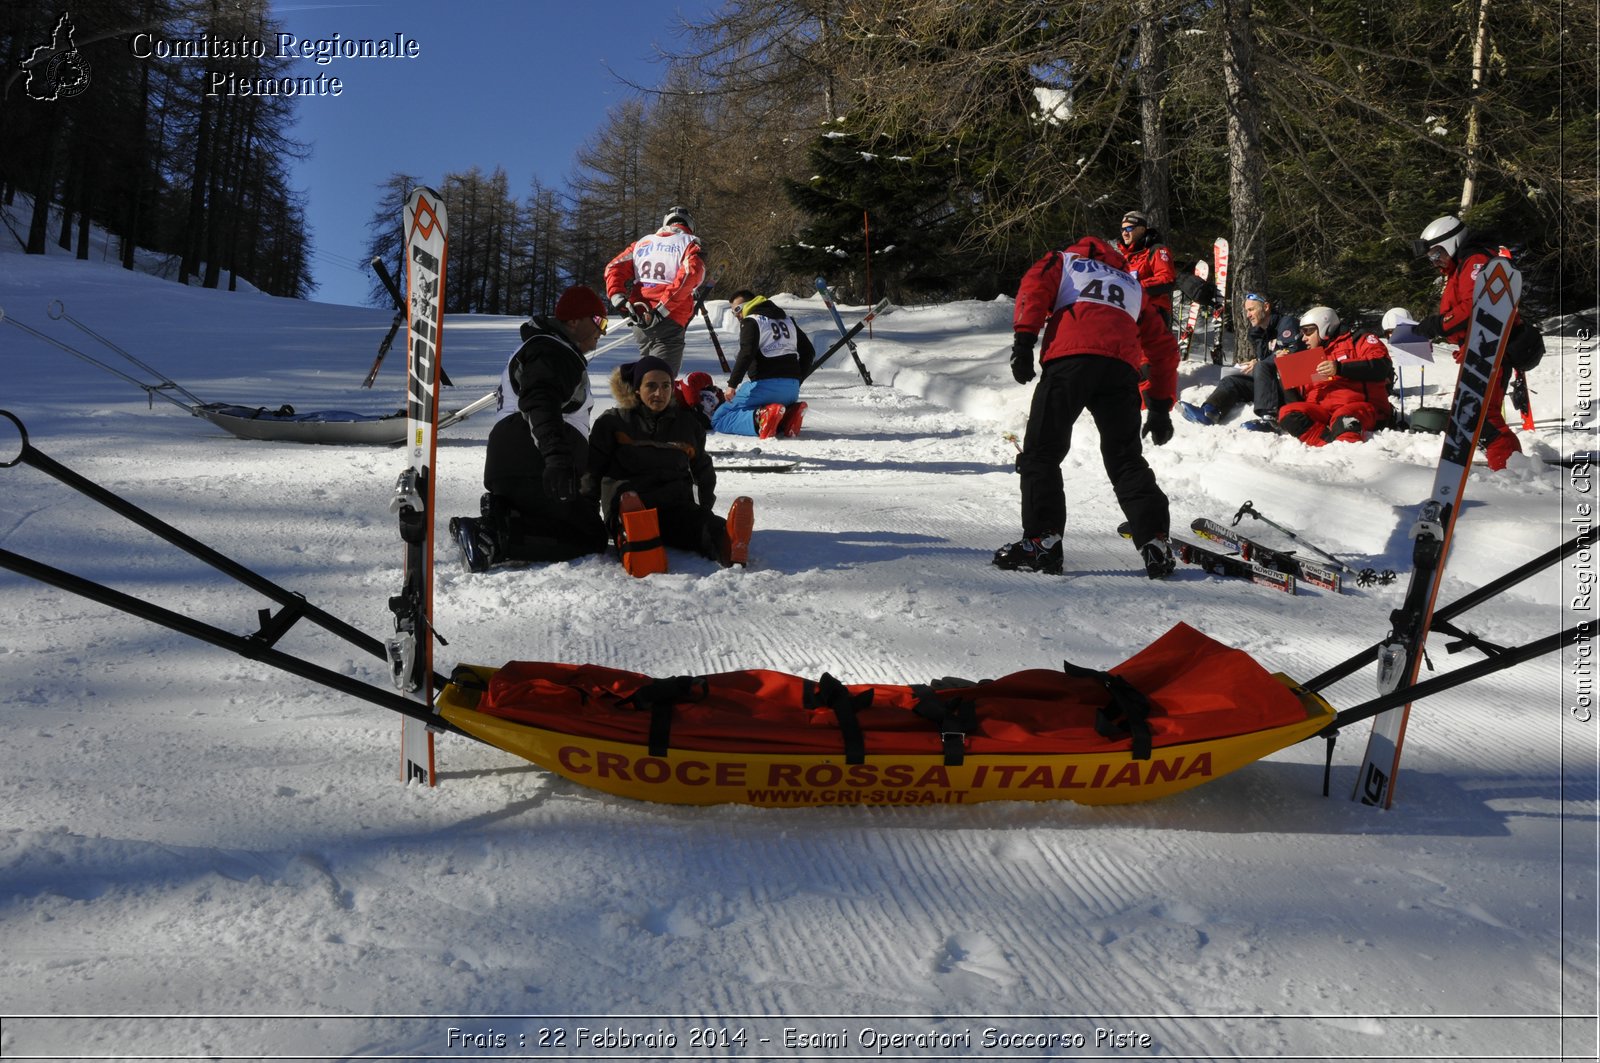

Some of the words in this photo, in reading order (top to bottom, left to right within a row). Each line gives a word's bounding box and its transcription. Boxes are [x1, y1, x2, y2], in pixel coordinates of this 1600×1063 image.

[641, 260, 666, 280] 88
[1080, 279, 1126, 309] 48
[771, 321, 790, 340] 99
[1254, 565, 1285, 580] SALOMON
[558, 746, 747, 787] CROCE
[767, 762, 952, 788] ROSSA
[971, 751, 1213, 788] ITALIANA
[747, 789, 969, 804] WWW.CRI-SUSA.IT
